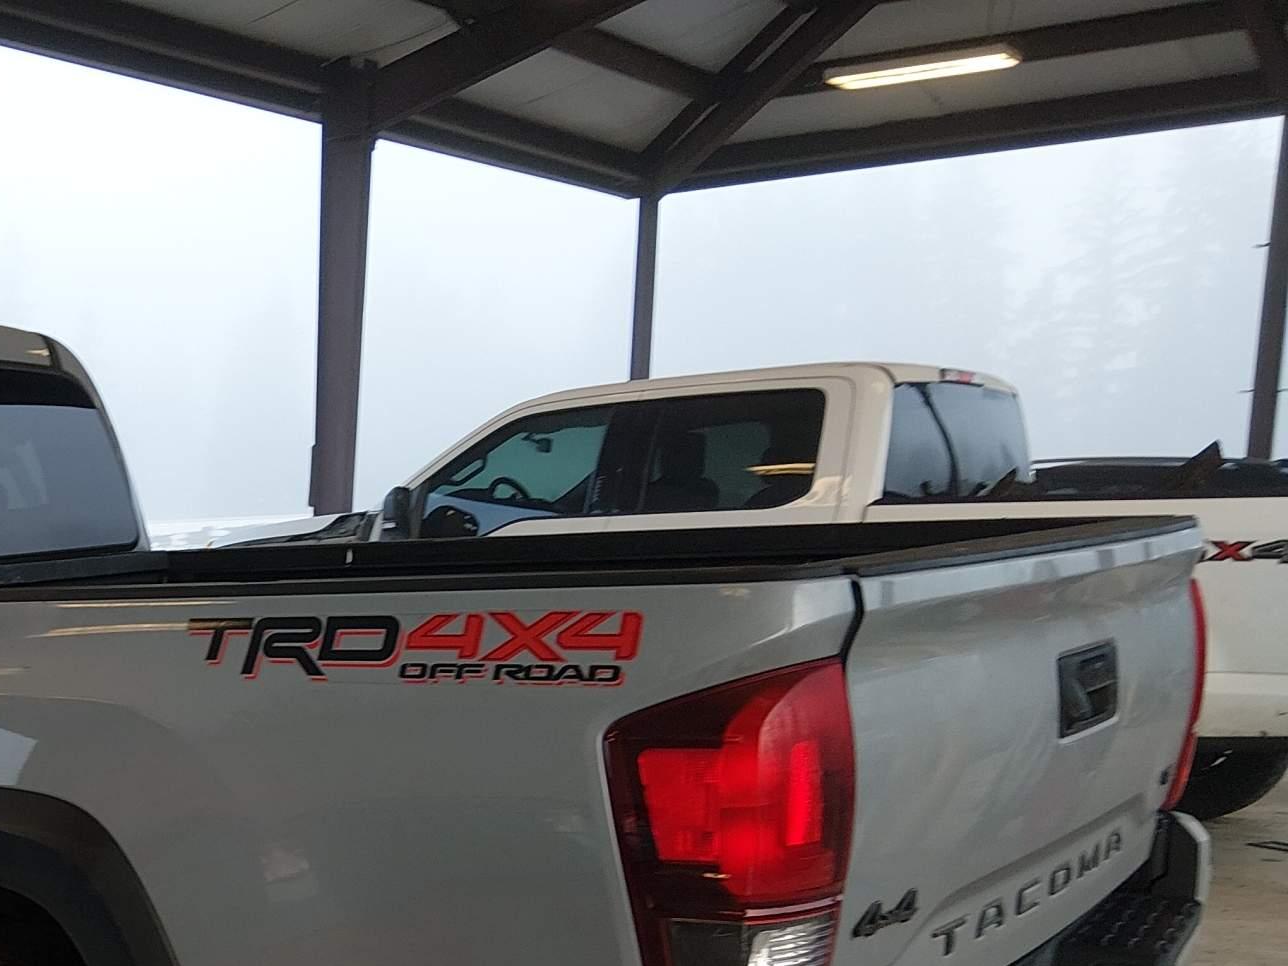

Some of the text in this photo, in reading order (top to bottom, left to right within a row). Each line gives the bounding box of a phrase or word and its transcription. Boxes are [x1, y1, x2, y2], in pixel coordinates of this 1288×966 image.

[1197, 538, 1288, 564] X4
[188, 610, 644, 680] TRD 4X4
[399, 662, 624, 686] OFF ROAD
[851, 887, 919, 938] 44
[931, 832, 1121, 956] TACOMA
